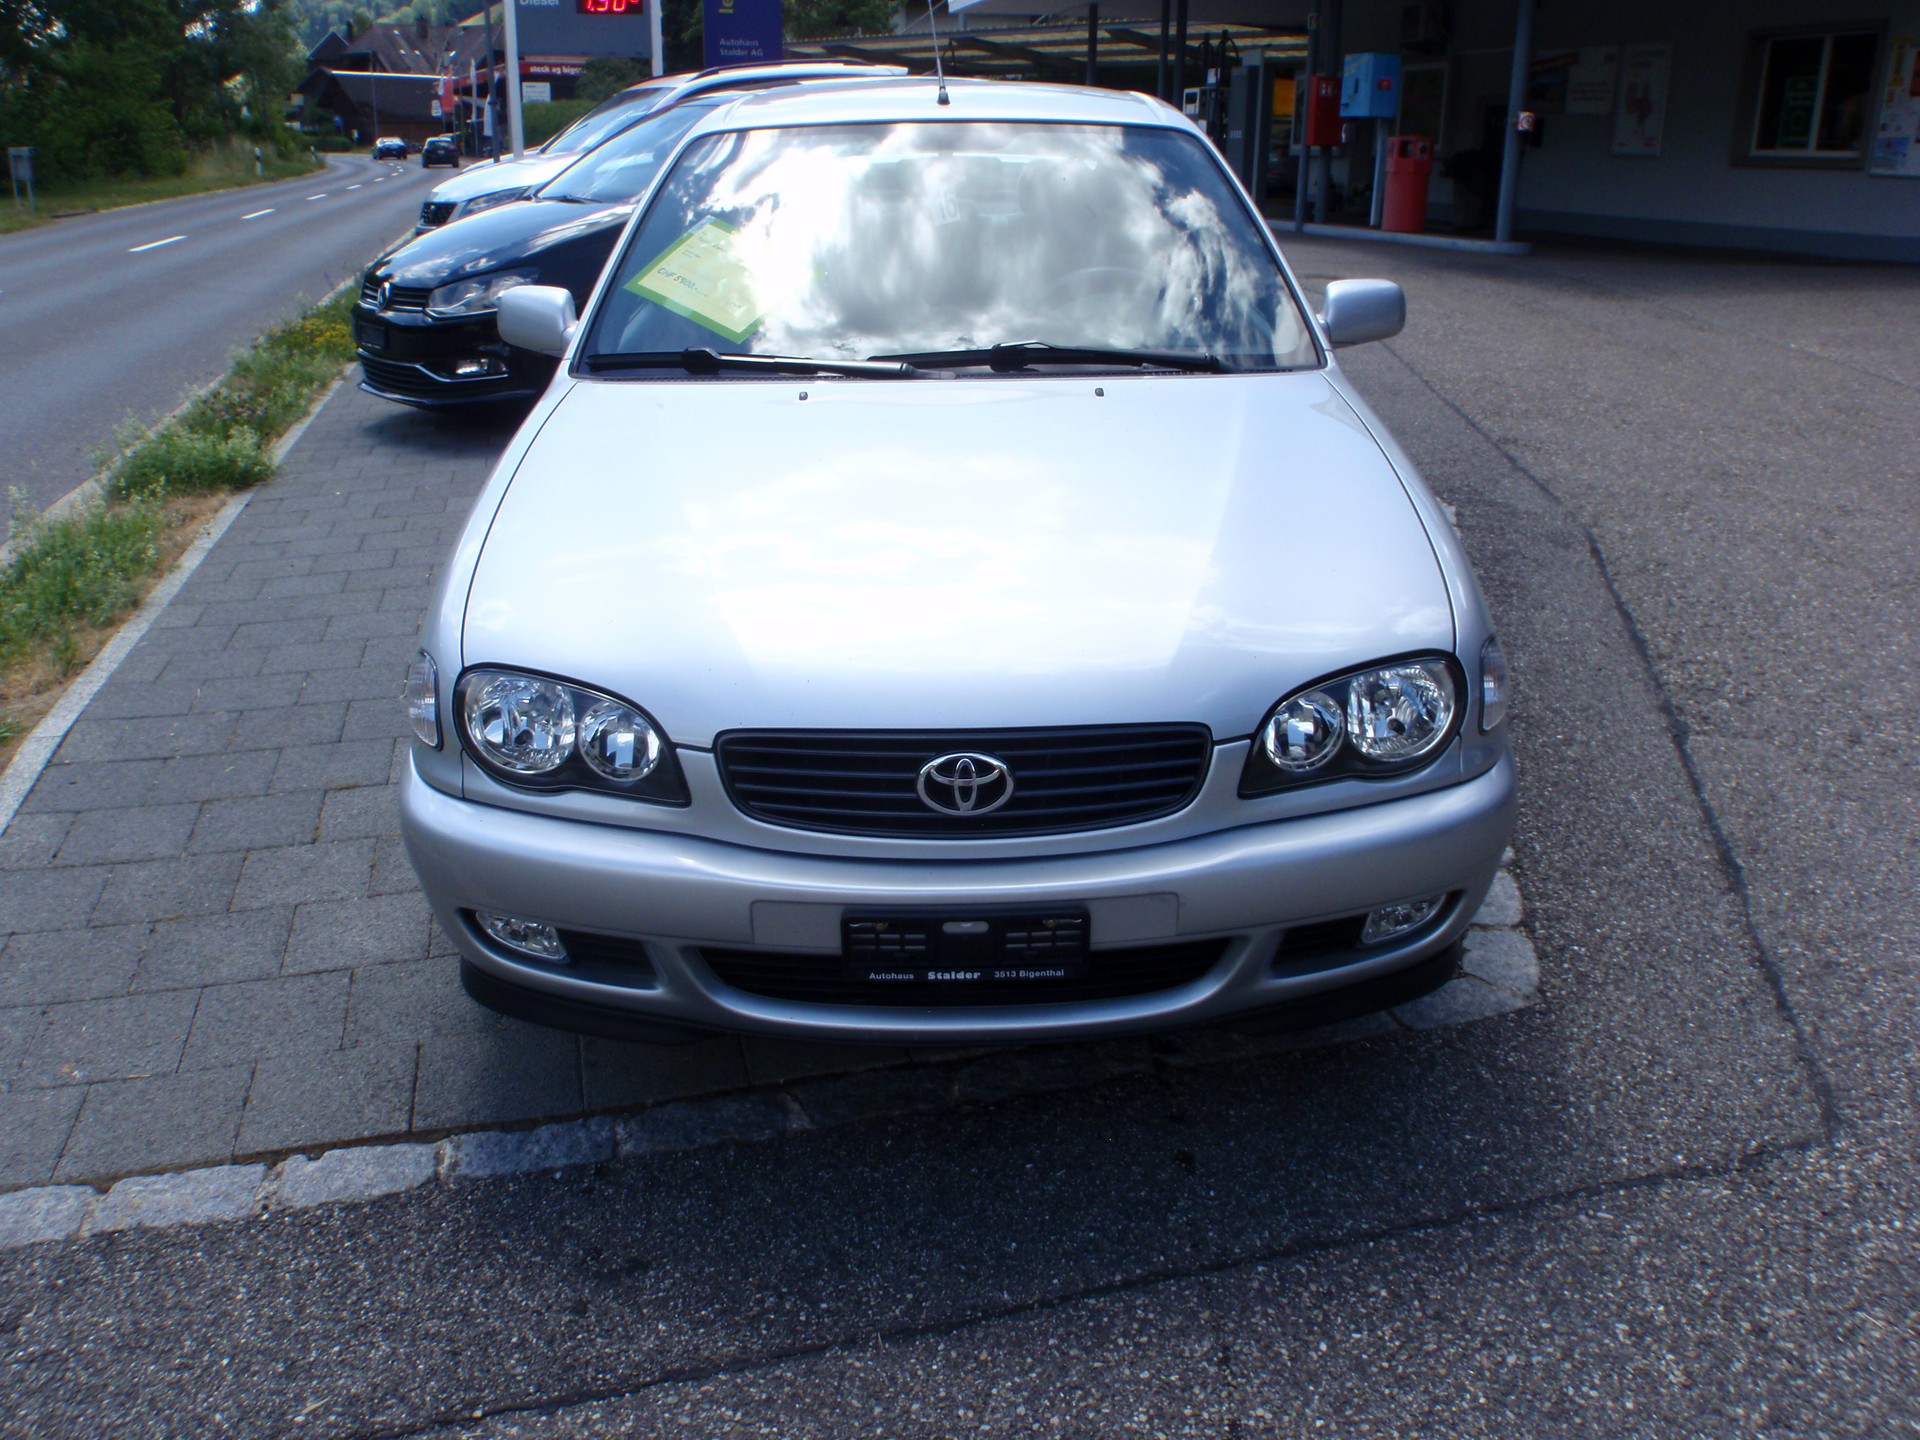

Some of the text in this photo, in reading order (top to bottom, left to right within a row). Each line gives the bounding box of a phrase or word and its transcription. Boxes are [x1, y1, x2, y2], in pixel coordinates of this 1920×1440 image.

[719, 38, 759, 46] Autohaus
[719, 48, 763, 56] Stalder AG
[868, 969, 1065, 980] Autohaus Stalder 3513 Bigenthal
